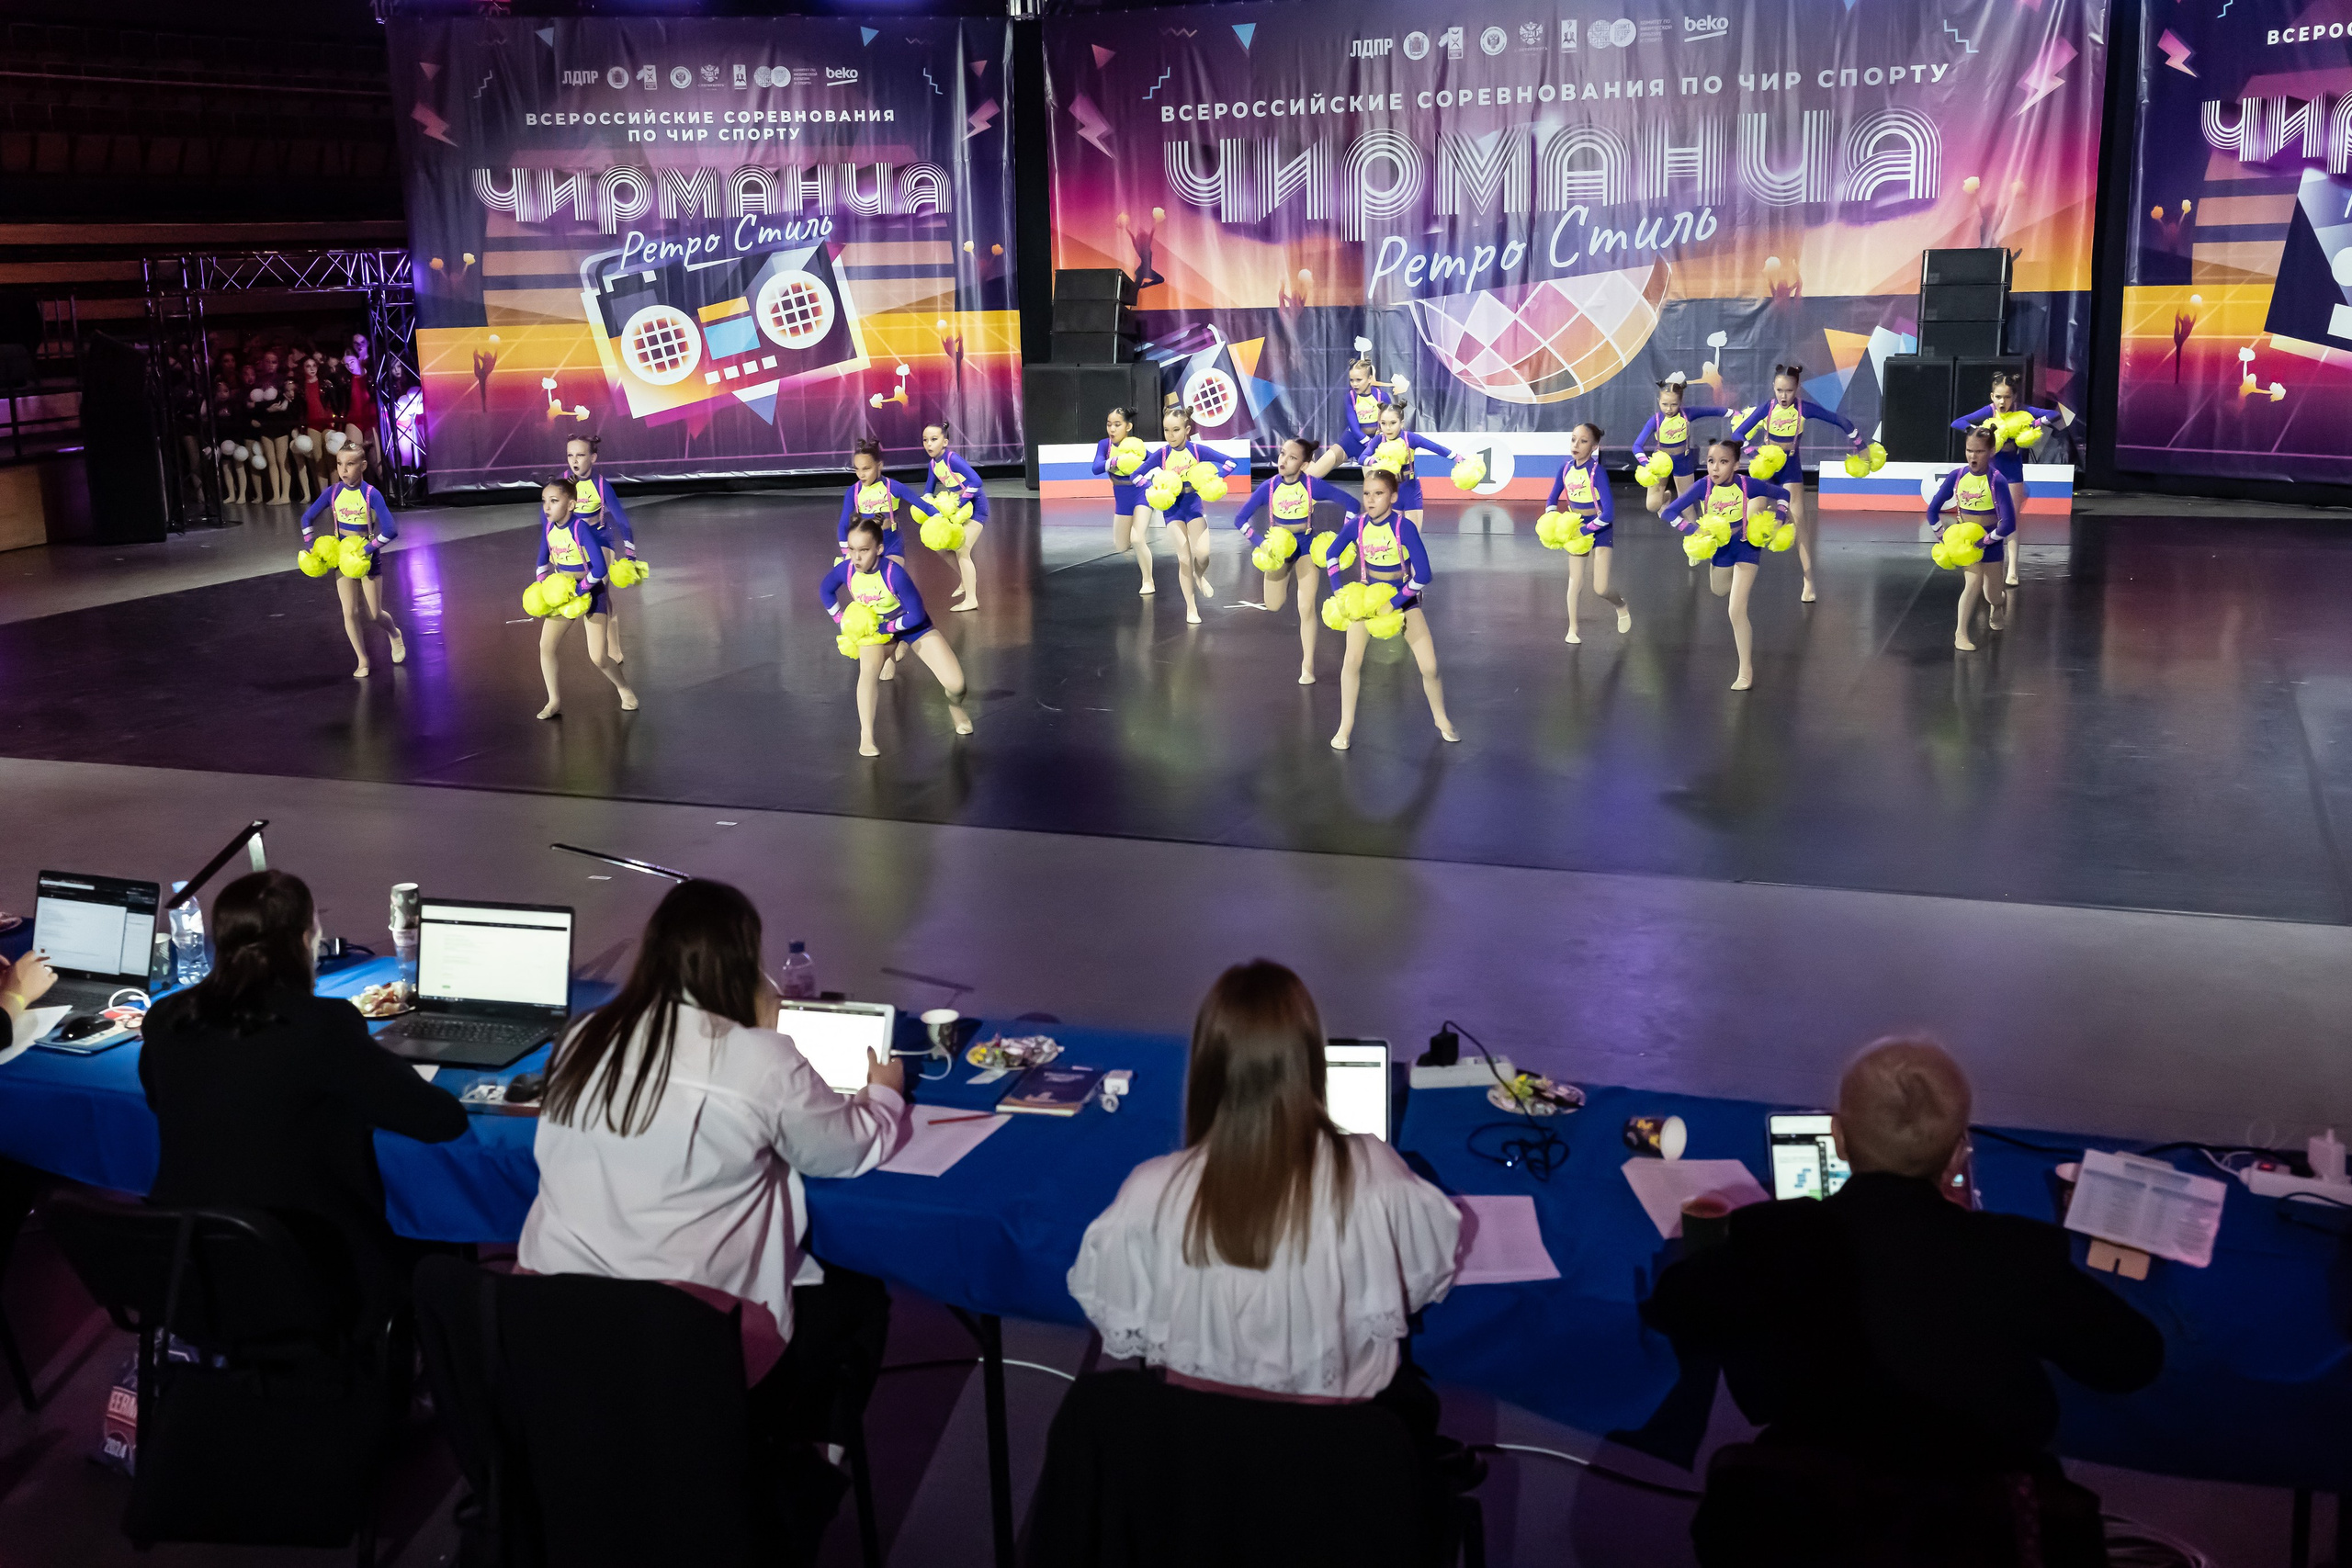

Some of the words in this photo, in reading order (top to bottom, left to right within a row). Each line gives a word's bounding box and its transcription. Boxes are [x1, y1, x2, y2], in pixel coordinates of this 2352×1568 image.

[1684, 15, 1729, 32] beko
[1349, 38, 1394, 59] ЛДПР
[562, 70, 599, 86] ЛДПР
[826, 66, 858, 80] beko
[1161, 93, 1403, 122] ВСЕРОССИЙСКИЕ
[1418, 79, 1664, 108] СОРЕВНОВАНИЯ
[1681, 76, 1723, 95] ПО
[1738, 72, 1801, 91] ЧИР
[1817, 63, 1949, 88] СПОРТУ
[526, 109, 714, 126] ВСЕРОССИЙСКИЕ
[724, 109, 895, 124] СОРЕВНОВАНИЯ
[628, 130, 656, 142] ПО
[667, 129, 708, 141] ЧИР
[718, 128, 800, 141] СПОРТУ
[620, 231, 721, 270] Ретро
[734, 213, 833, 252] Стиль
[1368, 235, 1527, 299] Ретро
[1550, 206, 1717, 267] Стиль
[1476, 447, 1496, 483] 1
